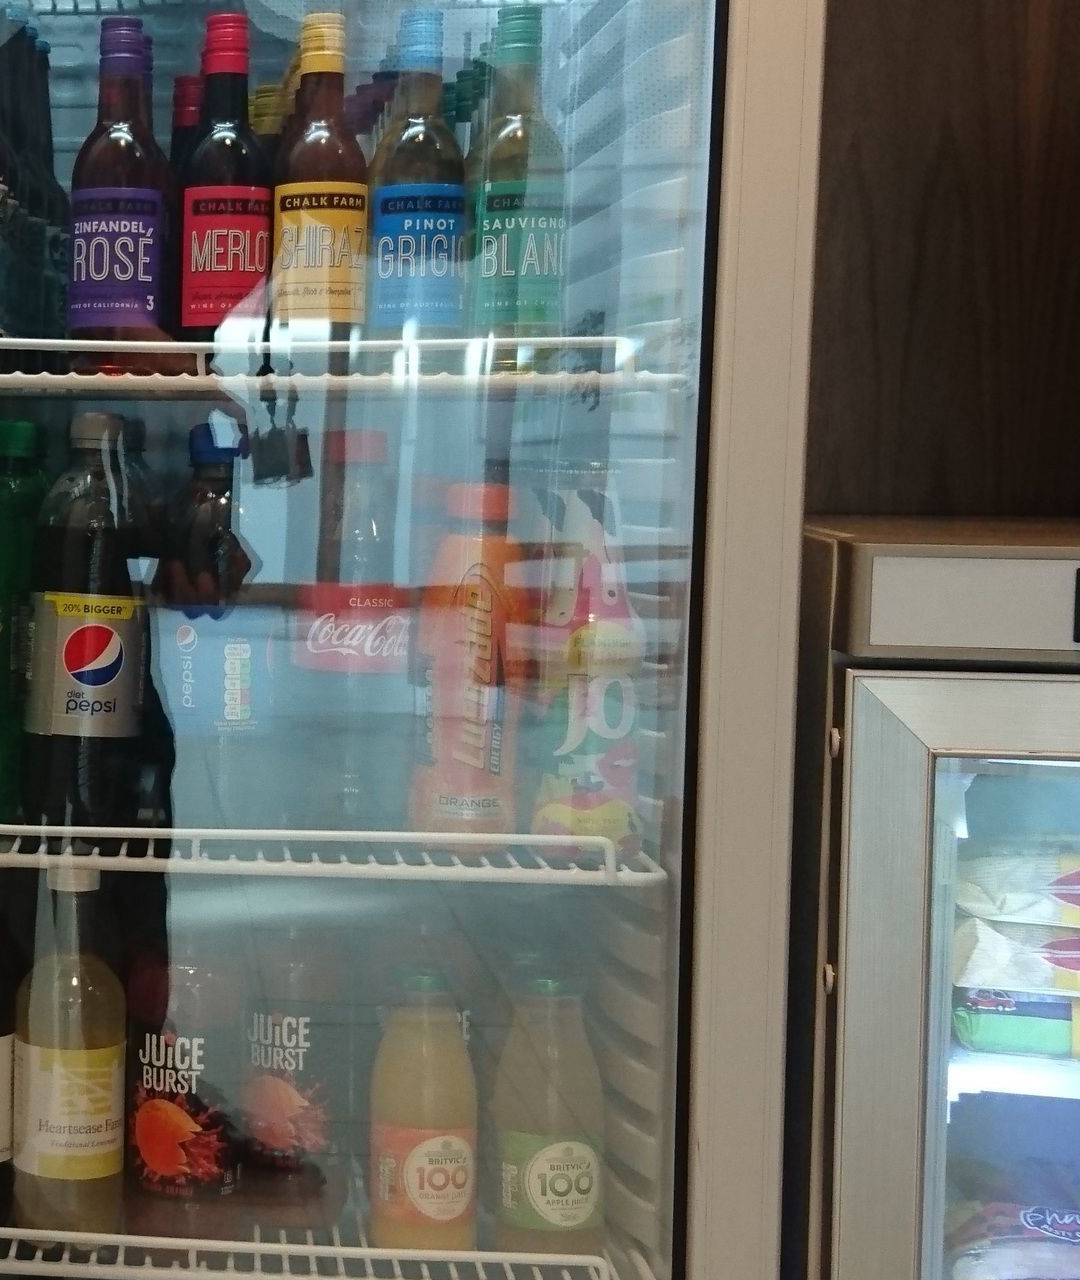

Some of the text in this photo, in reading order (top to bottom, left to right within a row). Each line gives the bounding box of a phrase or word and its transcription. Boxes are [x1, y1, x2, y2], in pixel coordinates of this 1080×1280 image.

[199, 201, 243, 213] CHALK
[285, 196, 362, 208] CHALK FARM
[387, 199, 432, 211] CHALK
[74, 220, 146, 234] ZINFANDEL
[403, 219, 456, 231] PINOT
[280, 224, 366, 270] SHIRAZ
[73, 227, 154, 282] ROSÉ
[63, 603, 81, 613] 20%
[349, 597, 394, 608] CLASSIC
[182, 655, 196, 708] pepsi
[67, 690, 85, 699] diet
[65, 698, 117, 716] pepsi
[490, 723, 501, 773] ENERGY
[439, 796, 500, 808] ORANGE
[250, 1047, 307, 1071] BURST
[142, 1066, 201, 1095] BURST
[38, 1118, 103, 1135] Heartsease
[416, 1166, 468, 1192] 100
[538, 1170, 594, 1198] 100
[420, 1191, 450, 1200] ORANGE
[546, 1198, 569, 1207] APPLE
